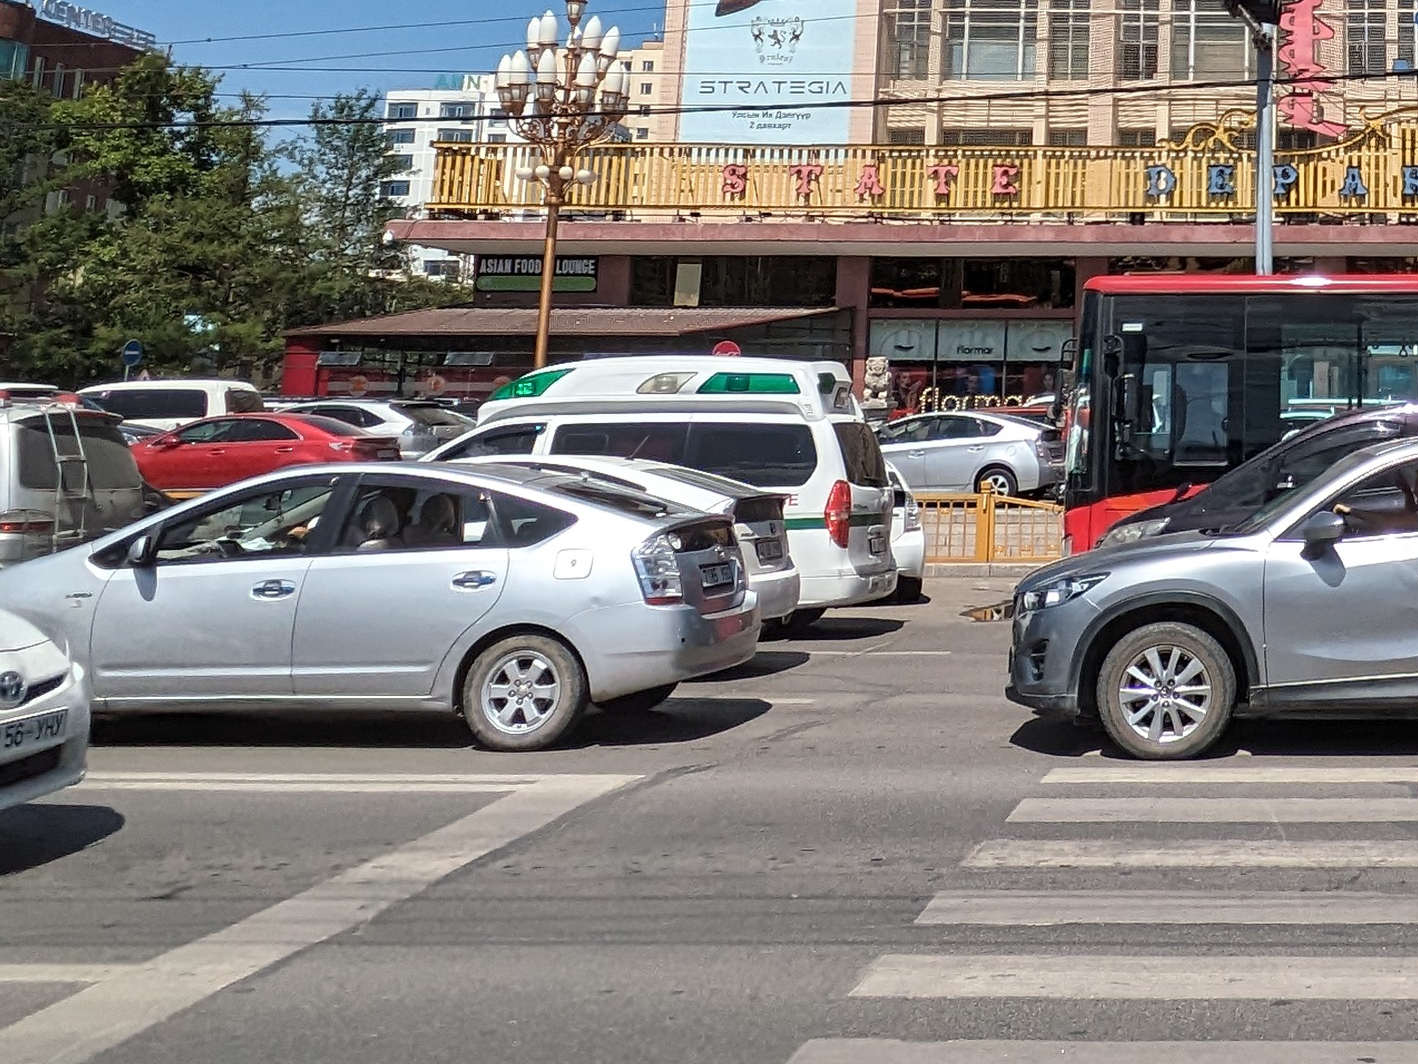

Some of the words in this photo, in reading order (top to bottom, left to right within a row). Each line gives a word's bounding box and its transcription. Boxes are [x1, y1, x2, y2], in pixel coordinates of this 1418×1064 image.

[699, 81, 847, 95] STRATEGIA
[722, 163, 1018, 196] STATE
[479, 258, 512, 274] ASIAN
[514, 258, 542, 274] FOOD
[555, 259, 596, 275] LOUNGE
